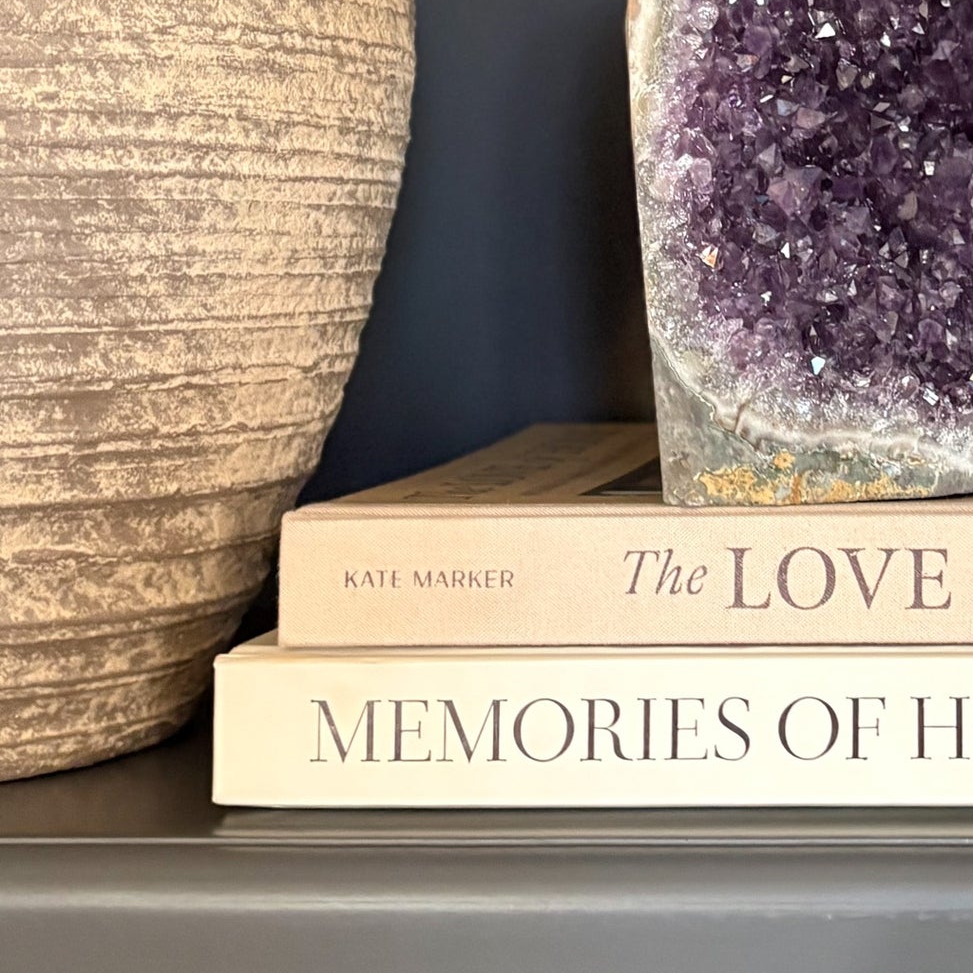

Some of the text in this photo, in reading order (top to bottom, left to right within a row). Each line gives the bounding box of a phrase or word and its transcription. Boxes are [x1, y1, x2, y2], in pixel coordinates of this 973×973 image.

[344, 569, 514, 589] KATE MARKER
[624, 548, 707, 596] The
[726, 546, 951, 611] LOVE
[309, 697, 751, 762] MEMORIES
[777, 696, 886, 761] OF
